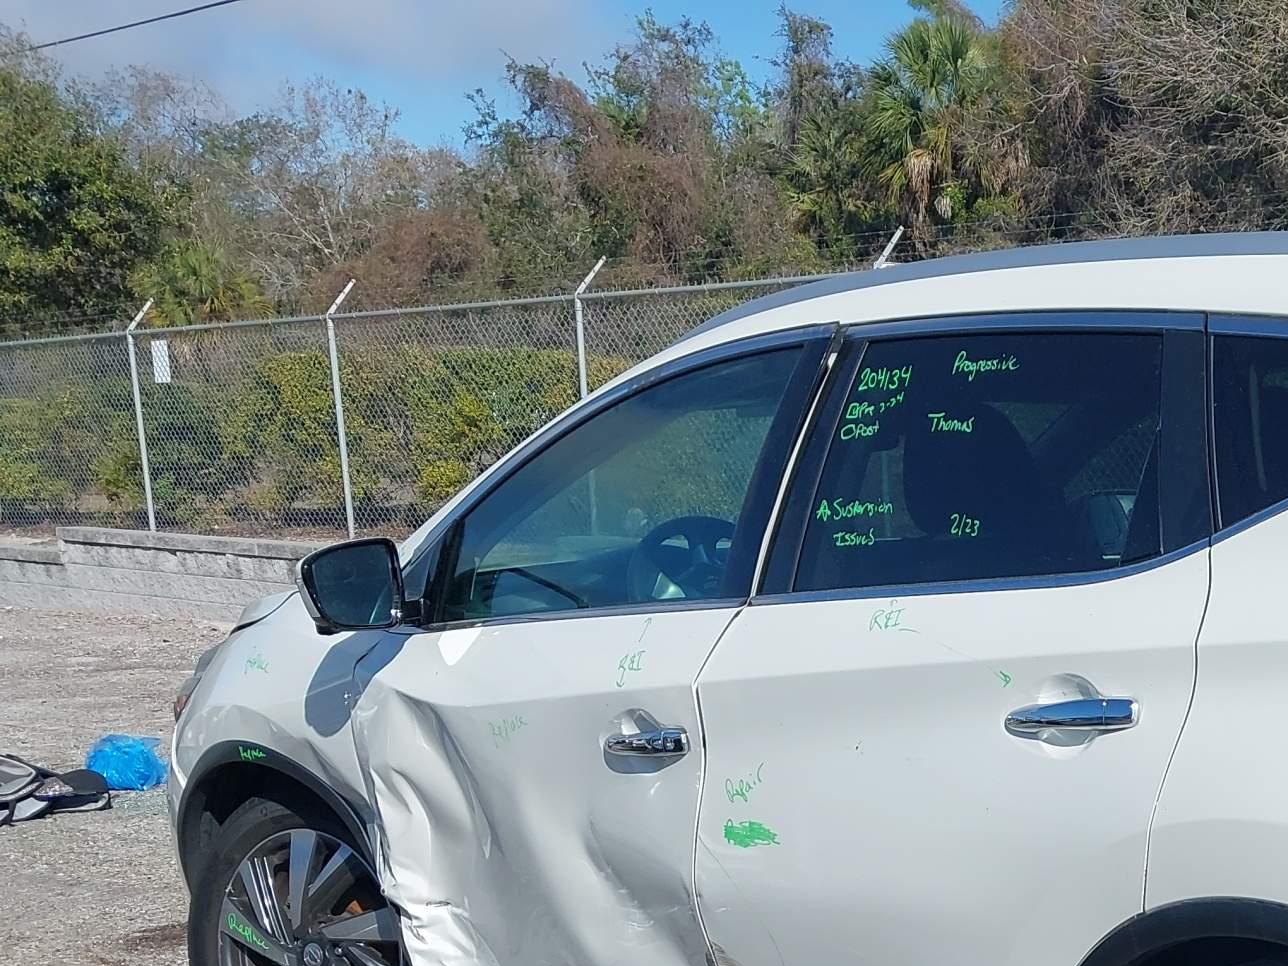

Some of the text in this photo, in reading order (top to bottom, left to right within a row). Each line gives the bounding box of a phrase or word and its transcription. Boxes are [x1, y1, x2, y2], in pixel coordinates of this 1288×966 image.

[952, 350, 1020, 381] Progressive
[855, 420, 880, 439] Post
[928, 412, 975, 432] Thomas
[950, 513, 980, 537] 2/23
